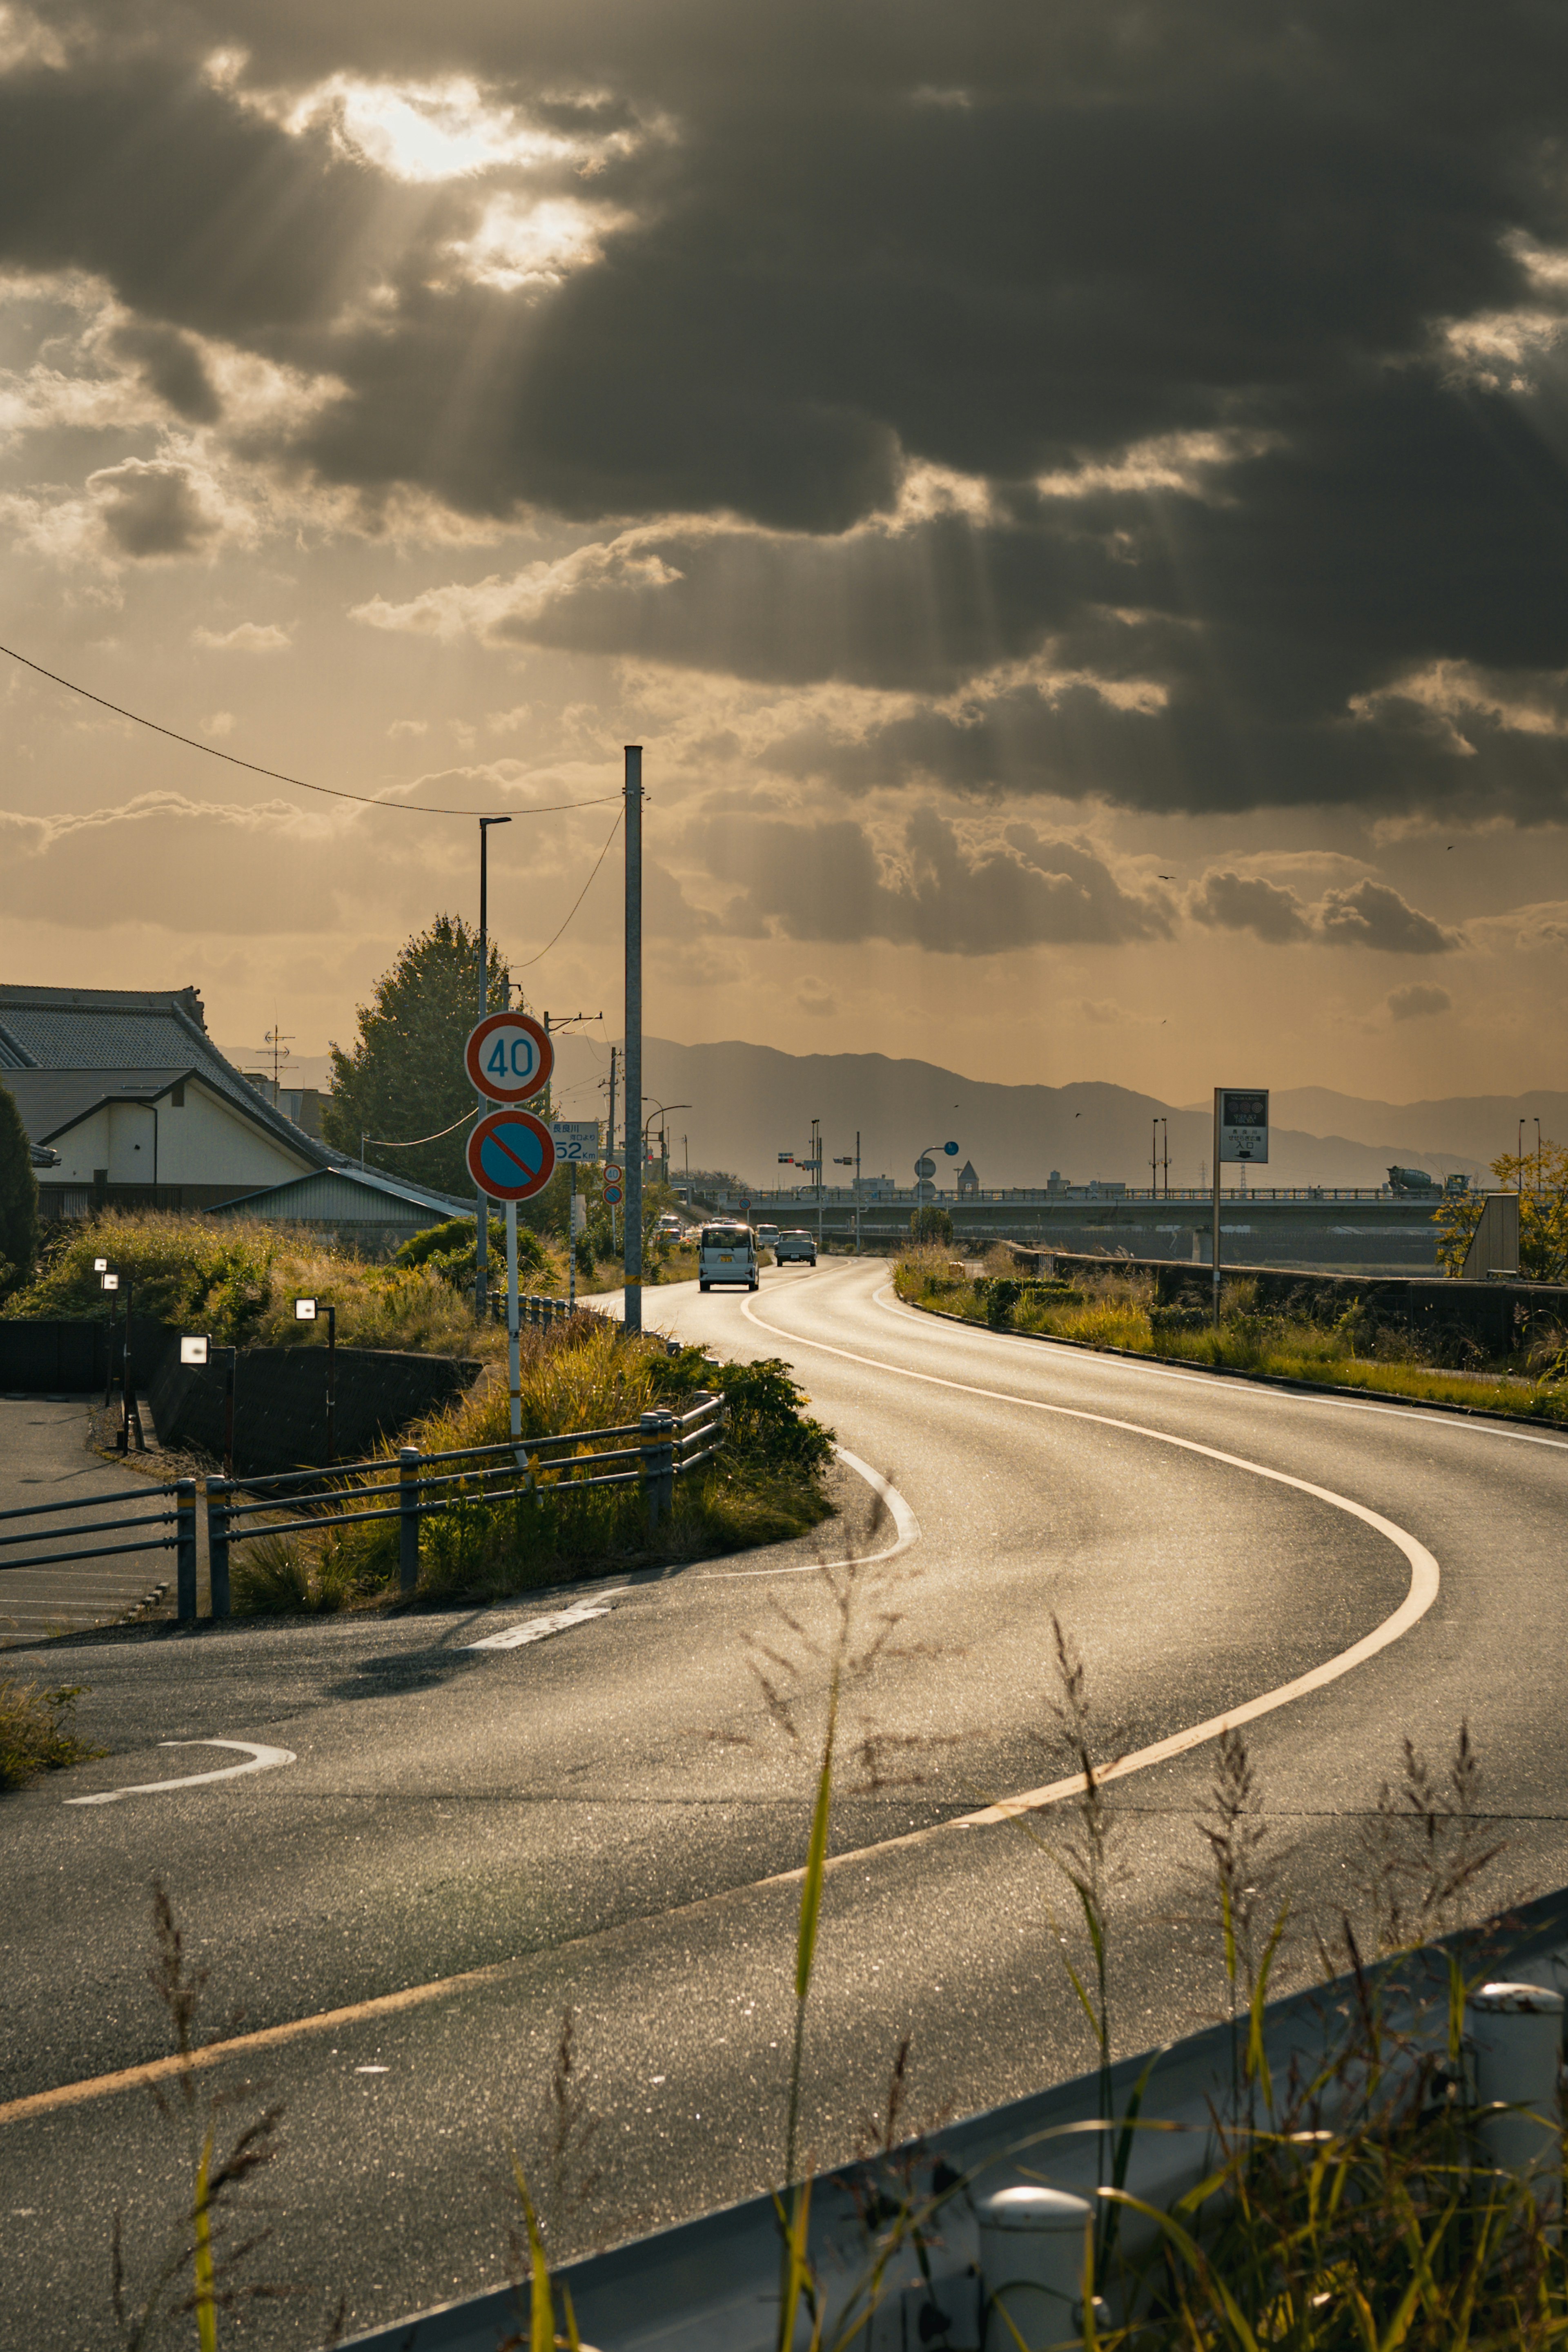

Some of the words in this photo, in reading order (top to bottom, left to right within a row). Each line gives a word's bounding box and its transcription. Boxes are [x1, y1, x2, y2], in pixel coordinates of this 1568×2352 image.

[487, 1039, 532, 1077] 40
[553, 1124, 579, 1133] 長良川
[608, 1169, 618, 1178] 40
